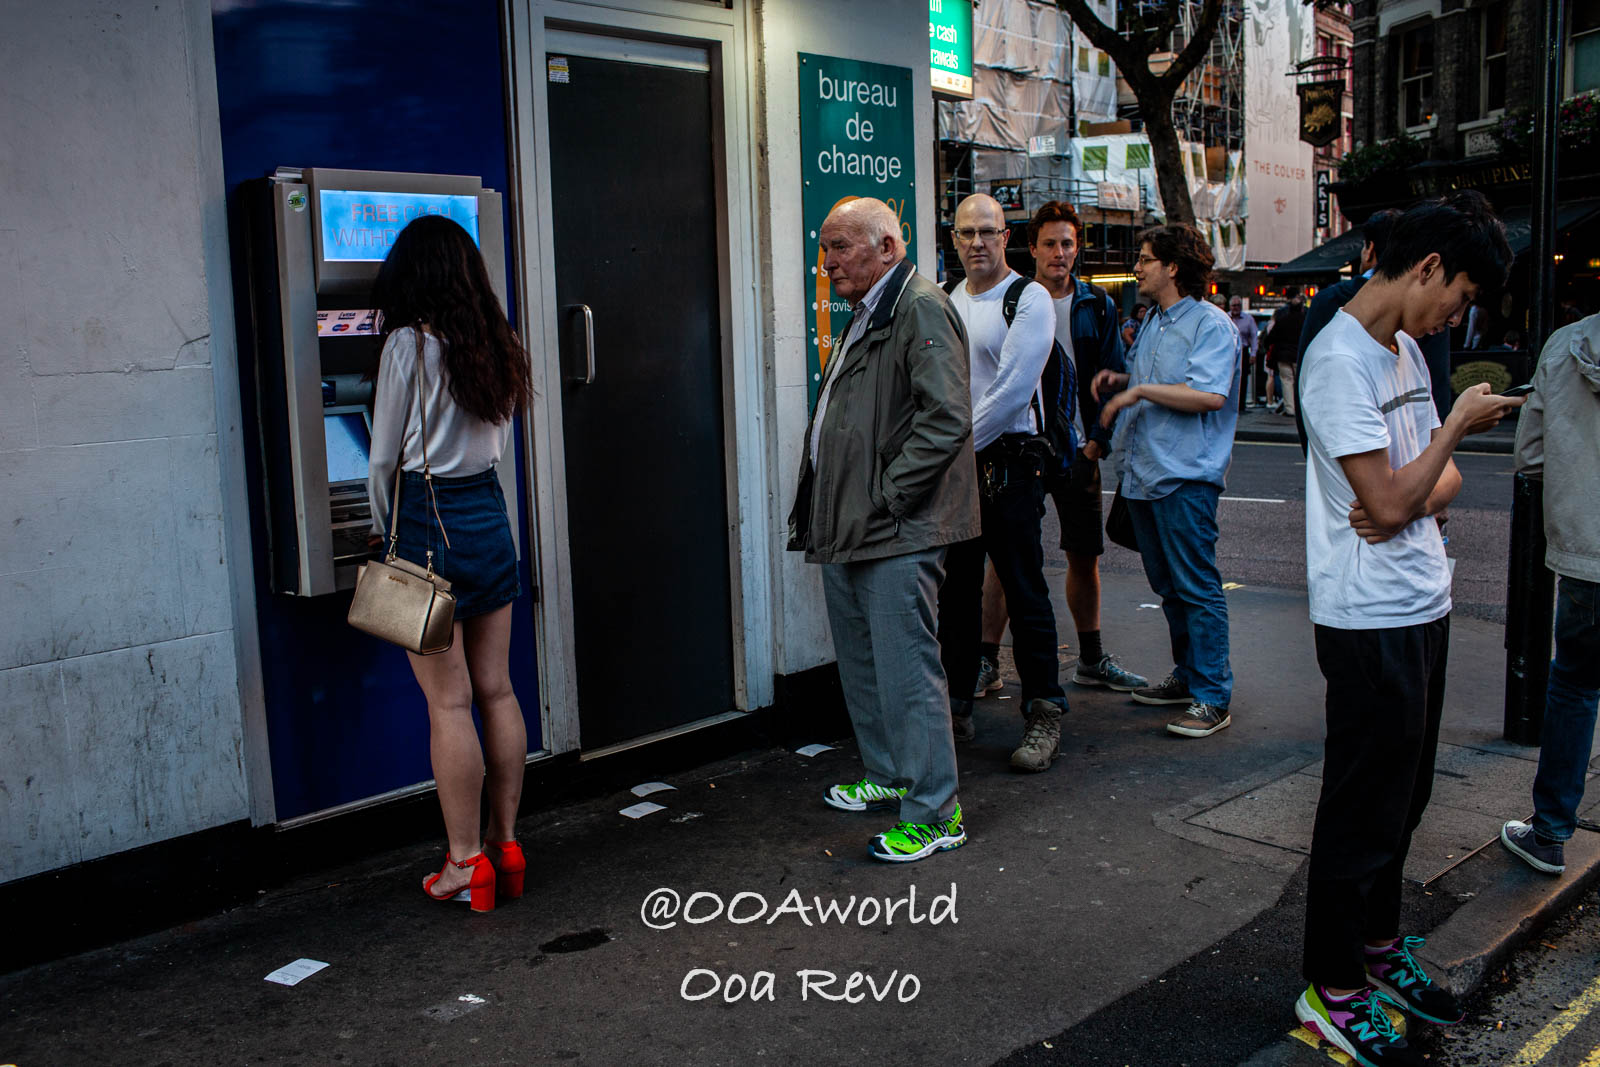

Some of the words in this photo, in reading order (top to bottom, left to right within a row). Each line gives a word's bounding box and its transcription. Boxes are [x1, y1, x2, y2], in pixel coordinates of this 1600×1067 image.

[937, 24, 958, 44] cash
[818, 69, 898, 108] bureau
[845, 112, 874, 142] de
[818, 145, 902, 184] change
[1253, 160, 1271, 176] THE
[1318, 172, 1330, 226] ARTS
[351, 203, 399, 222] FREE
[332, 228, 402, 247] WITHD
